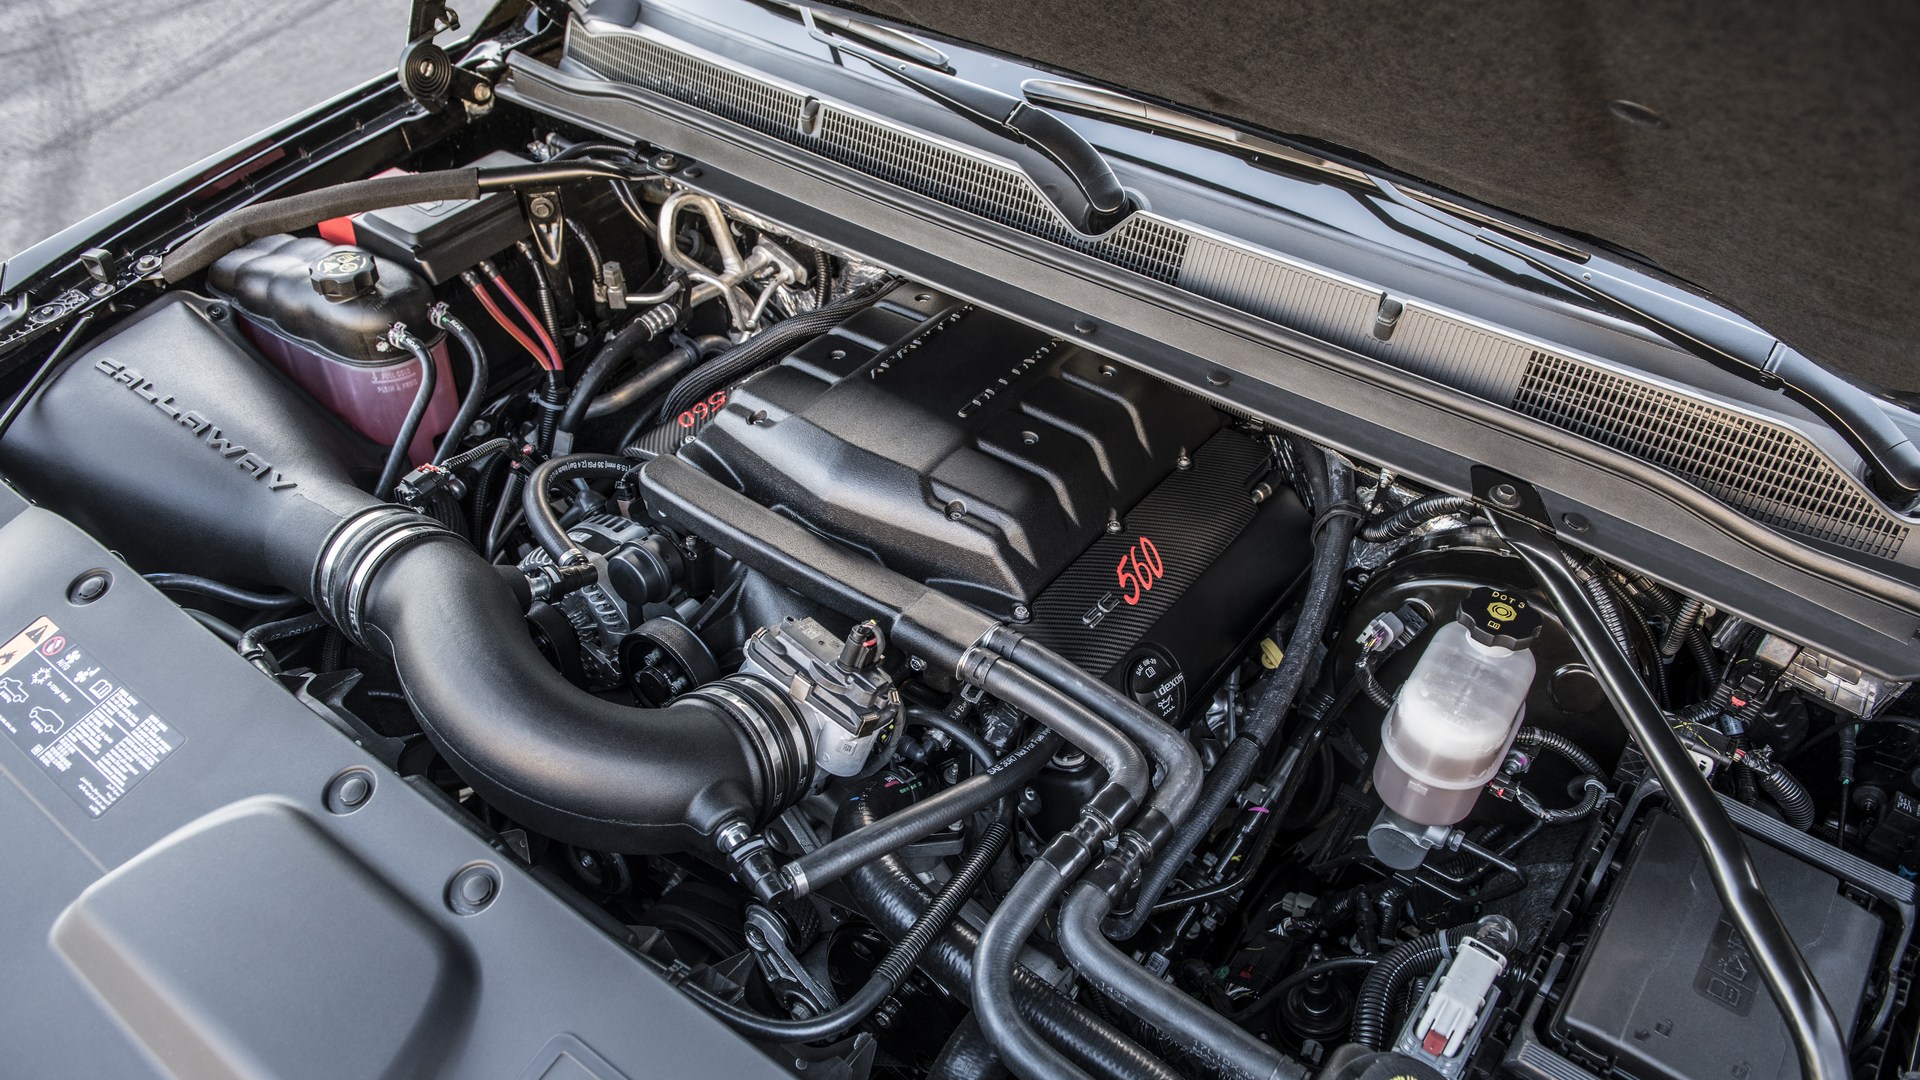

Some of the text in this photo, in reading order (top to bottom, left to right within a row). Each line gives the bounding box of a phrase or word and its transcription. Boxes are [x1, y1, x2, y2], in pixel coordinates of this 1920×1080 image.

[677, 390, 727, 428] 560
[94, 357, 298, 491] CALLAWAY
[1082, 536, 1164, 629] SC 560
[1491, 590, 1526, 609] DOT 3
[56, 658, 71, 671] AUTO
[1135, 663, 1144, 677] SAE
[1158, 672, 1184, 696] dexos
[986, 764, 1004, 775] SAE
